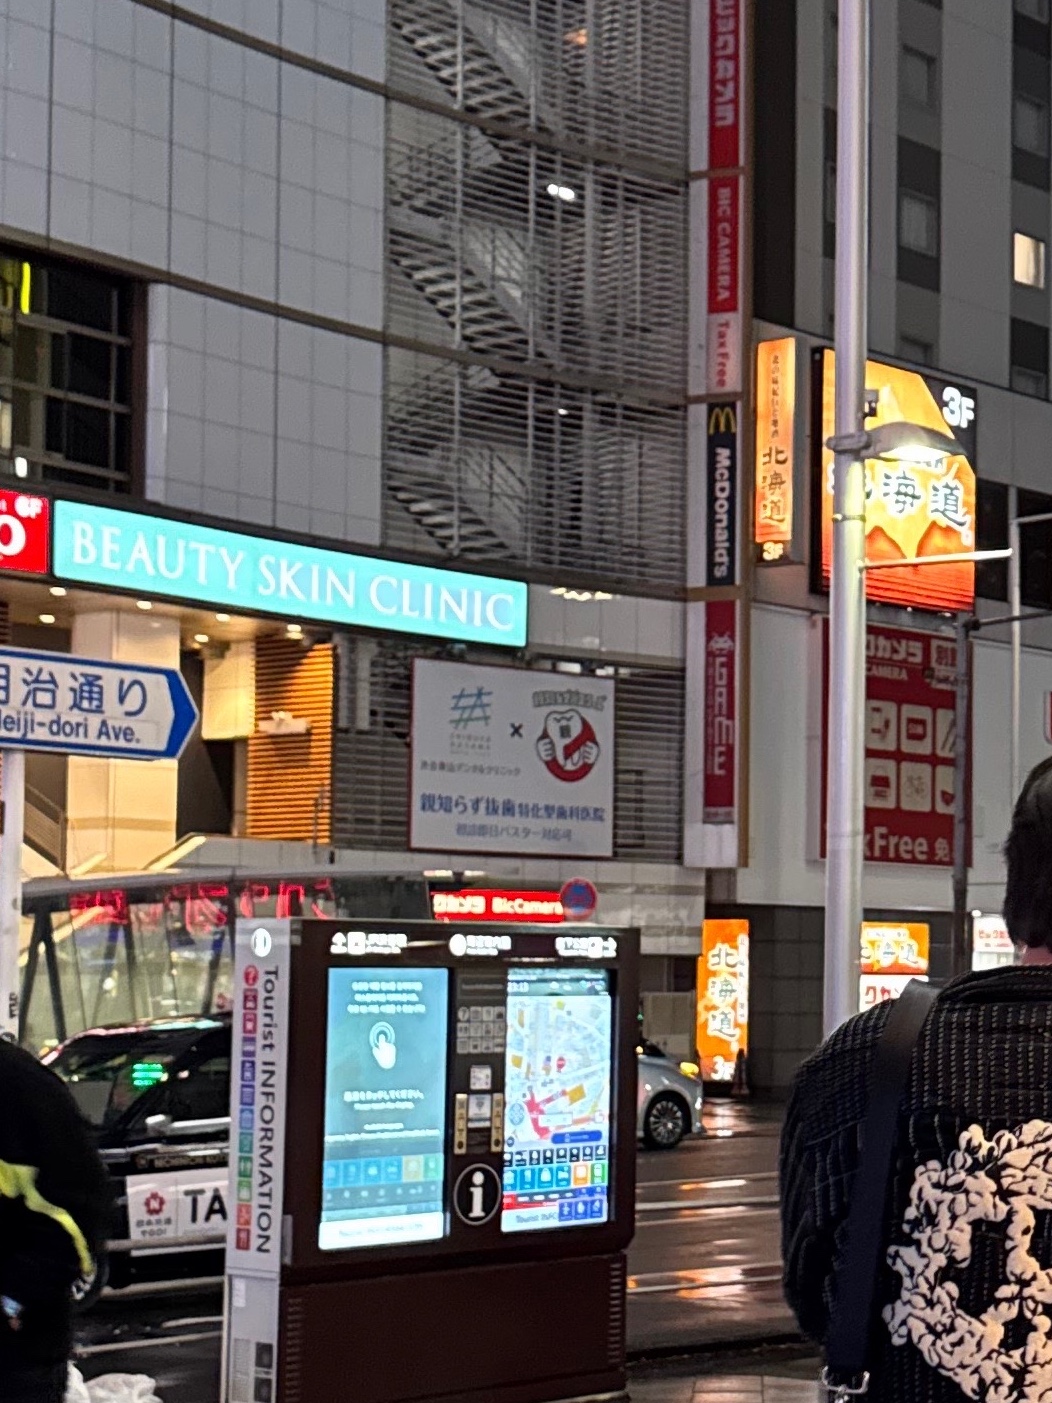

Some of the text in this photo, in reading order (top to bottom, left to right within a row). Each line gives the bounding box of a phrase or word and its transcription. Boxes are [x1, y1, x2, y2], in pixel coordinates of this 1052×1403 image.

[716, 187, 731, 301] BIC CAMERA
[715, 322, 730, 389] Tax Free
[942, 386, 975, 429] 3F
[714, 447, 731, 578] McDonald's
[762, 446, 788, 523] 北海道
[864, 465, 968, 528] 海道
[72, 520, 515, 631] BEAUTY SKIN CLINIC
[0, 710, 141, 744] eiji-dori Ave.
[873, 826, 929, 862] Free
[711, 947, 738, 1038] 北海道
[256, 965, 279, 1254] Tourist INFORMATION
